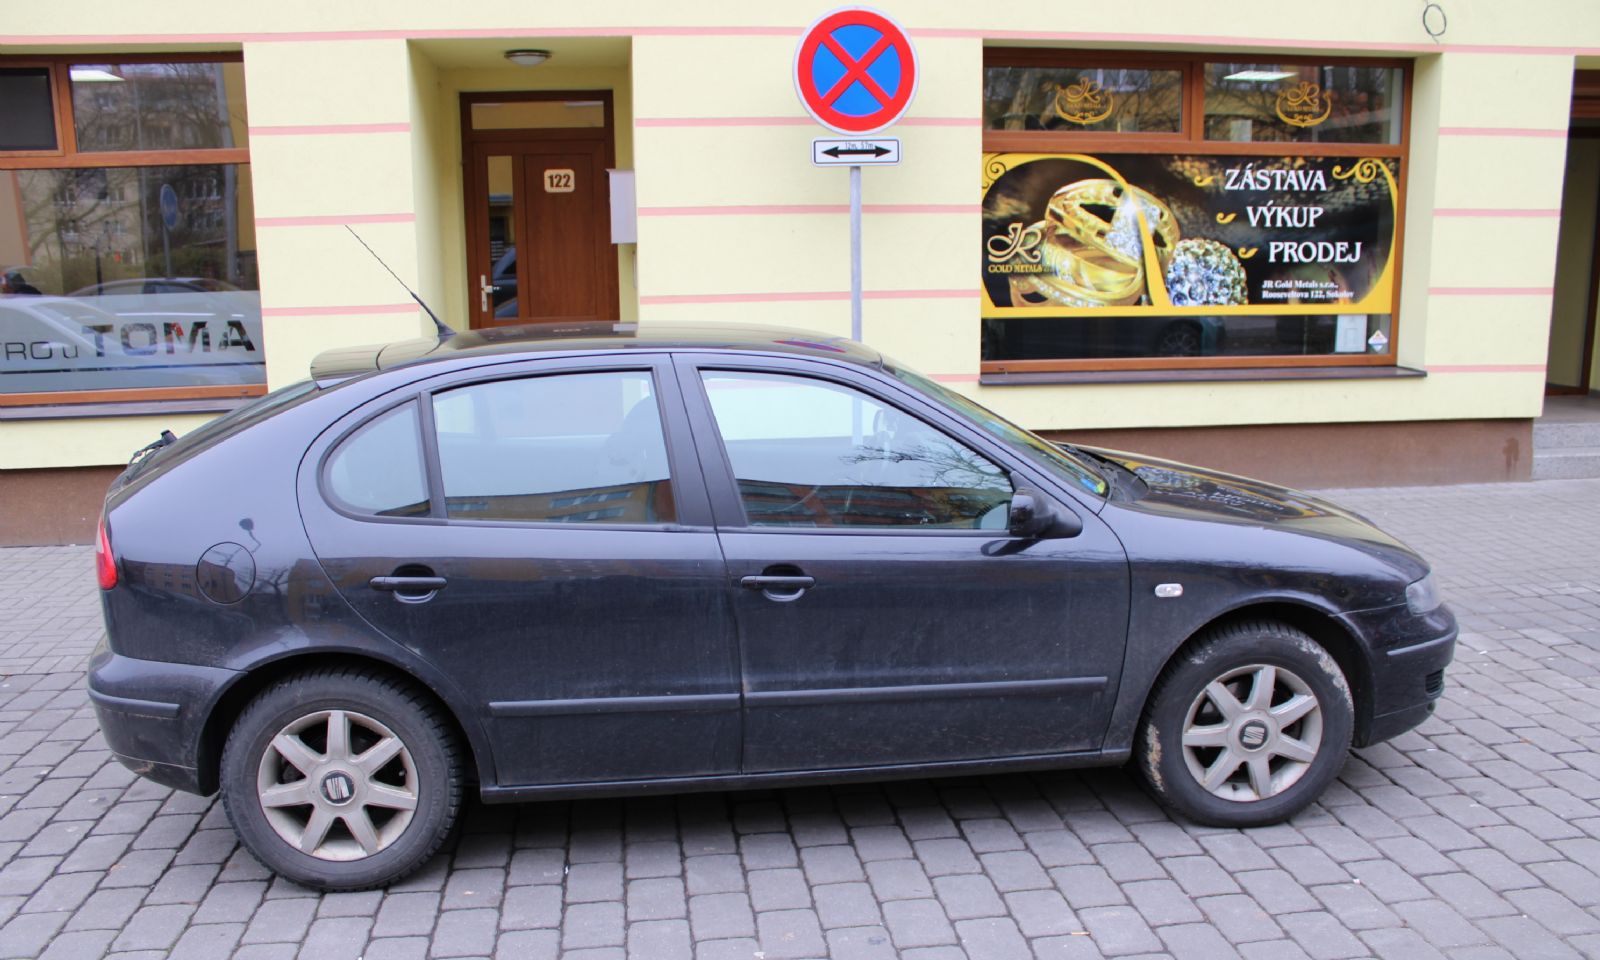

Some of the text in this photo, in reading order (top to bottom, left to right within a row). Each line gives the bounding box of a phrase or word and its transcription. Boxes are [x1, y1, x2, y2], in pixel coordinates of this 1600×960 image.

[548, 173, 571, 188] 122
[1224, 163, 1327, 191] ZÁSTAVA
[1246, 200, 1324, 228] VÝKUP
[1268, 241, 1362, 264] PRODEJ
[988, 264, 1012, 273] GOLD
[1014, 263, 1043, 273] METALS
[1262, 280, 1273, 289] JR
[1275, 280, 1292, 289] Gold
[1295, 280, 1318, 289] Metals
[0, 341, 53, 360] RO
[83, 320, 255, 357] TOMA
